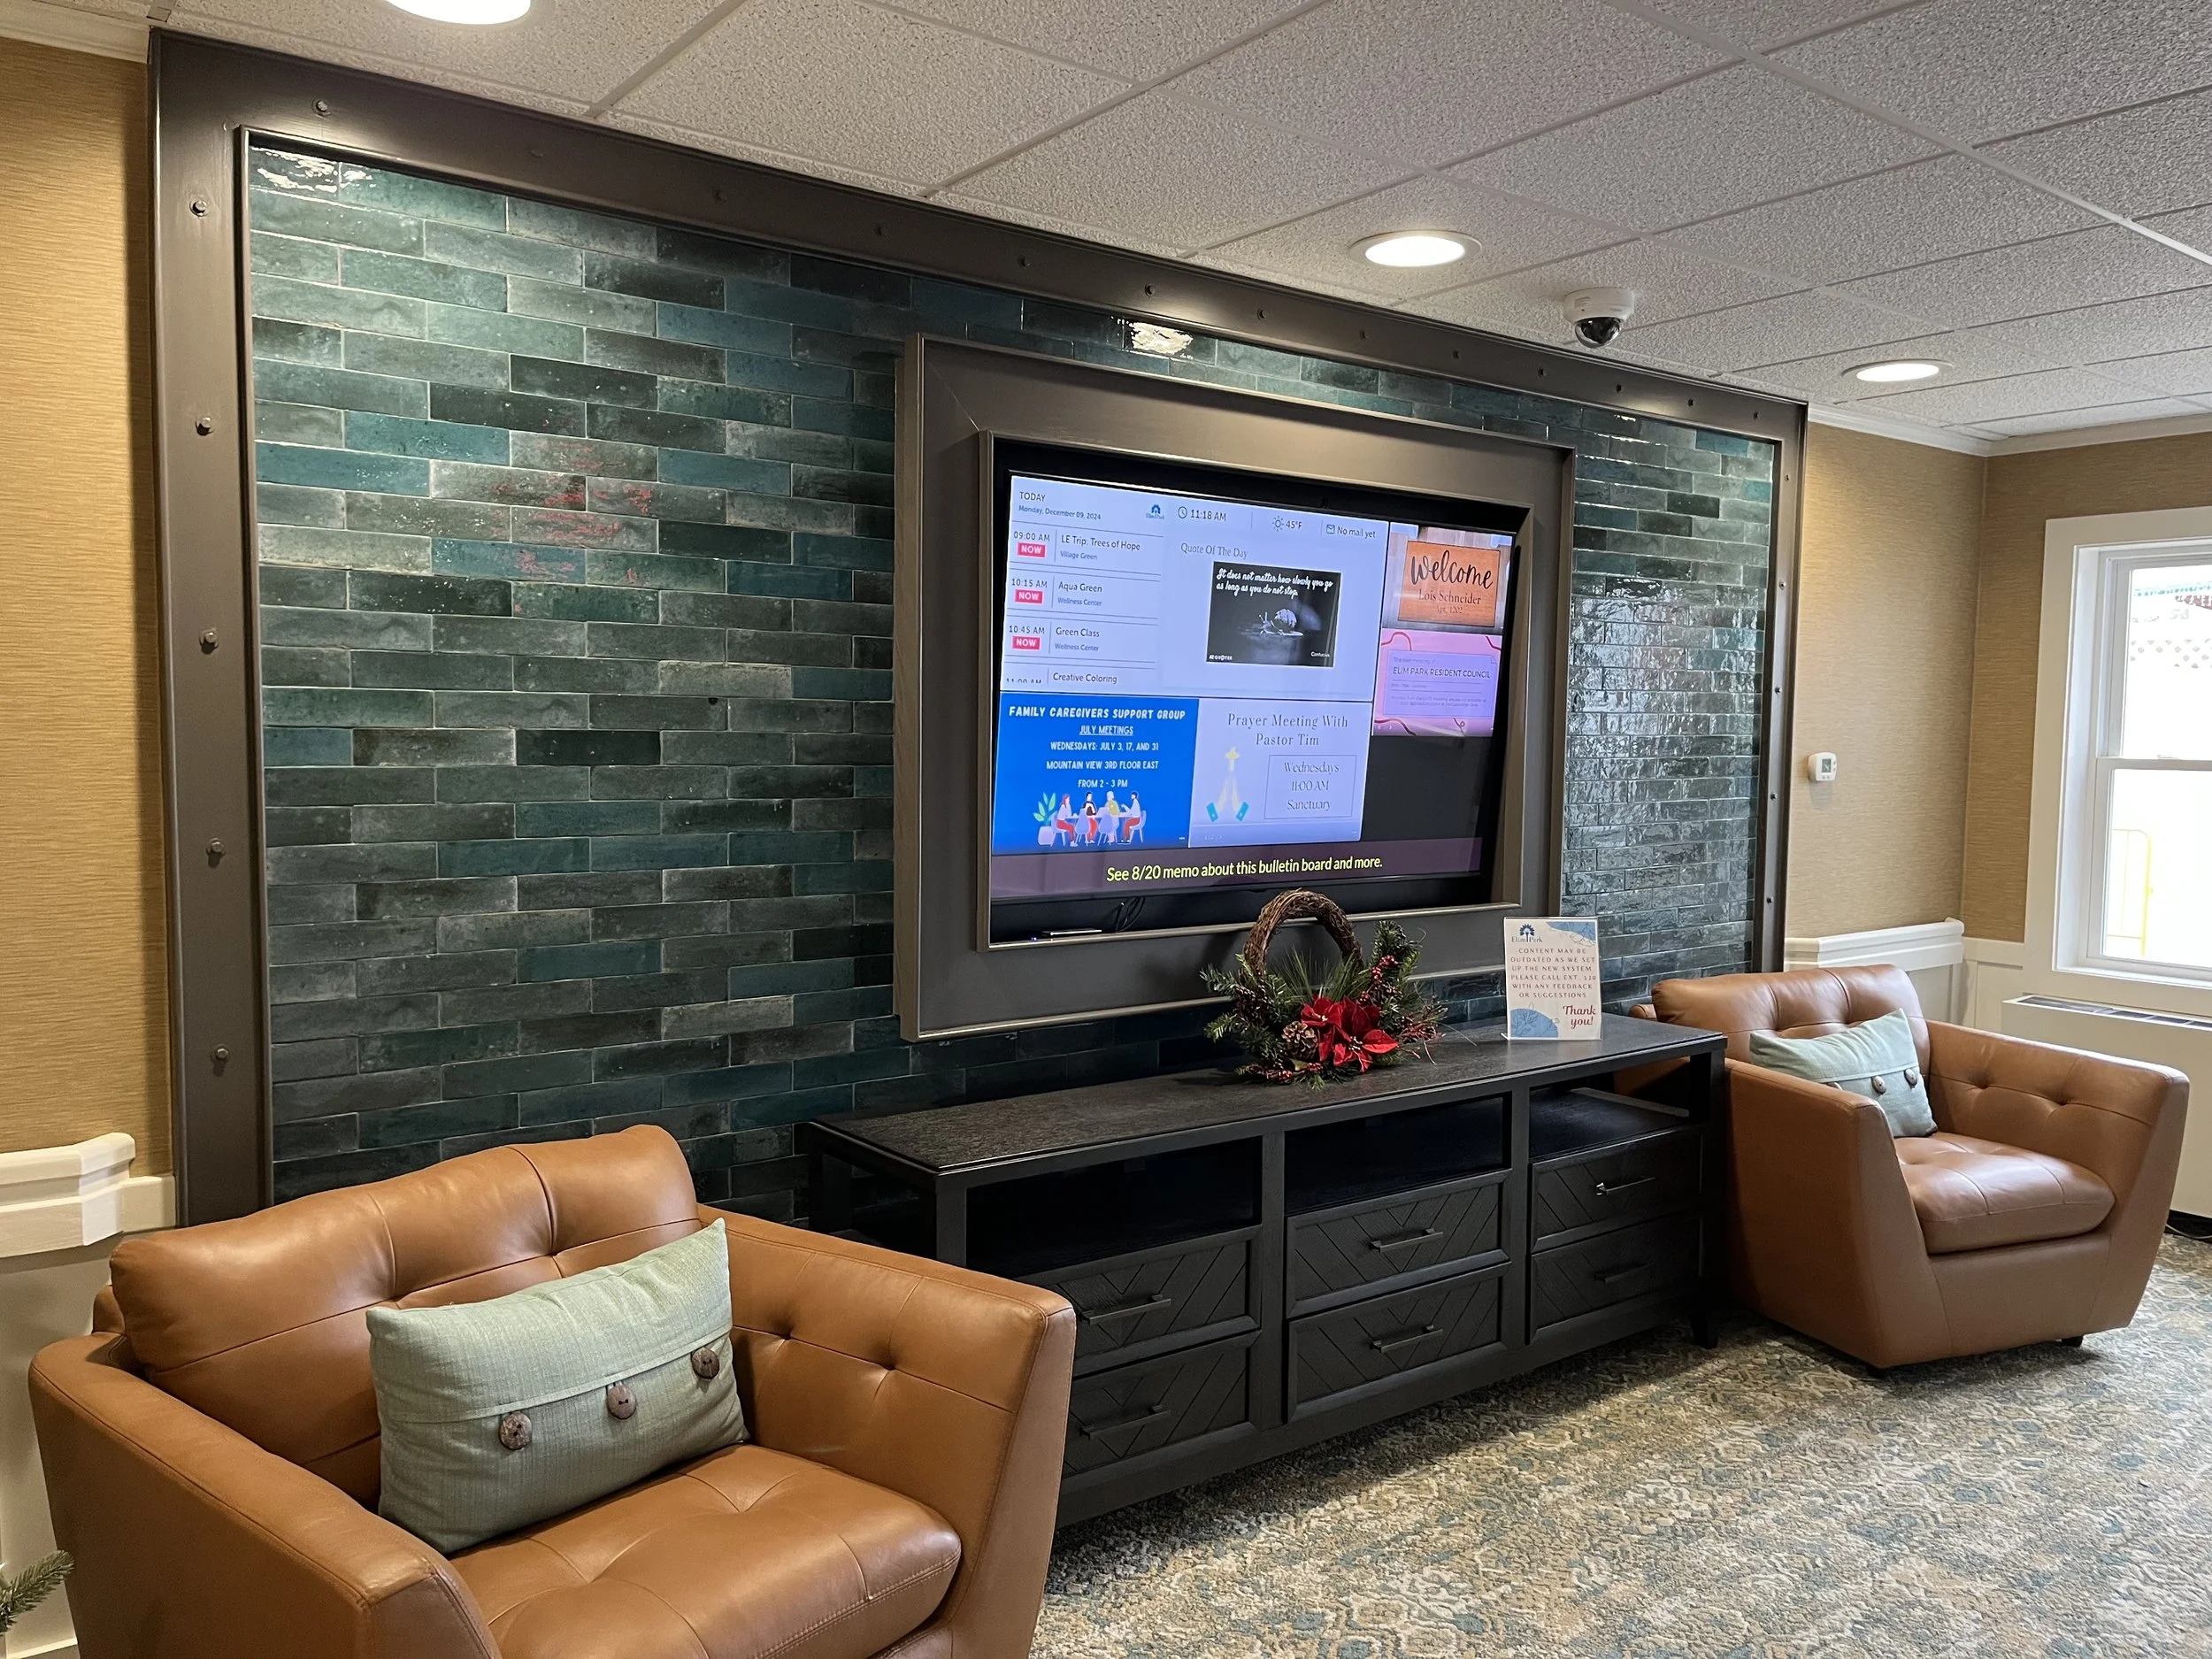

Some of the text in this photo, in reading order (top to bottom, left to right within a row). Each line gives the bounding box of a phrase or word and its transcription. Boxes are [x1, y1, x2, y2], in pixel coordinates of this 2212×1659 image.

[1019, 491, 1046, 503] TODAY
[1018, 504, 1044, 515] Monday,
[1045, 507, 1075, 518] December
[1087, 511, 1102, 520] 2024
[1190, 509, 1226, 522] 11:18 AM
[1286, 520, 1302, 530] 45°F
[1013, 531, 1050, 541] 09:00 AM
[1337, 526, 1376, 539] No mail yet
[1061, 534, 1141, 551] LE Trip: Trees of Hope
[1020, 544, 1042, 555] NOW
[1060, 550, 1079, 560] Village
[1180, 542, 1248, 559] Quote Of The Day
[1011, 578, 1048, 588] 10:15 AM
[1058, 580, 1102, 594] Aqua Green
[1227, 569, 1240, 580] does
[1242, 571, 1255, 581] not
[1255, 572, 1277, 582] matter
[1278, 572, 1292, 584] how
[1292, 574, 1311, 590] slowly
[1311, 580, 1325, 591] you
[1325, 581, 1334, 593] go
[1225, 580, 1240, 596] long
[1249, 585, 1263, 596] you
[1263, 583, 1272, 594] do
[1272, 585, 1284, 595] not
[1018, 591, 1040, 601] NOW
[1417, 588, 1482, 605] Lois Schneider
[1009, 625, 1031, 634] 10:45
[1056, 626, 1100, 638] Green Class
[1016, 638, 1037, 648] NOW
[1055, 642, 1079, 651] Wellness
[1053, 672, 1118, 685] Creative Coloring
[1410, 667, 1429, 676] PARK
[1430, 668, 1462, 678] RESIDENT
[1463, 670, 1491, 679] COUNCIL
[1009, 706, 1186, 720] FAMILY CAREGIVERS SUPPORT GROUP
[1227, 712, 1348, 731] Prayer Meeting With
[1079, 725, 1134, 735] JULY MEETINGS
[1256, 733, 1320, 746] Pastor Tim
[1099, 741, 1116, 751] JULY
[1117, 742, 1125, 752] 3,
[1125, 742, 1134, 752] 17,
[1135, 742, 1150, 751] AND
[1151, 742, 1159, 751] 31
[1046, 760, 1159, 770] MOUNTAIN VIEW 3RD FLOOR EAST
[1283, 761, 1340, 775] Wednesdays
[1078, 779, 1098, 788] FROM
[1099, 780, 1104, 788] 2
[1110, 780, 1116, 788] 3
[1117, 780, 1128, 788] PM
[1286, 799, 1332, 812] Sanctuary
[1106, 856, 1383, 882] See 8/20 memo about this bulletin board and more.
[1563, 1004, 1596, 1016] Thank
[1571, 1017, 1594, 1029] you!
